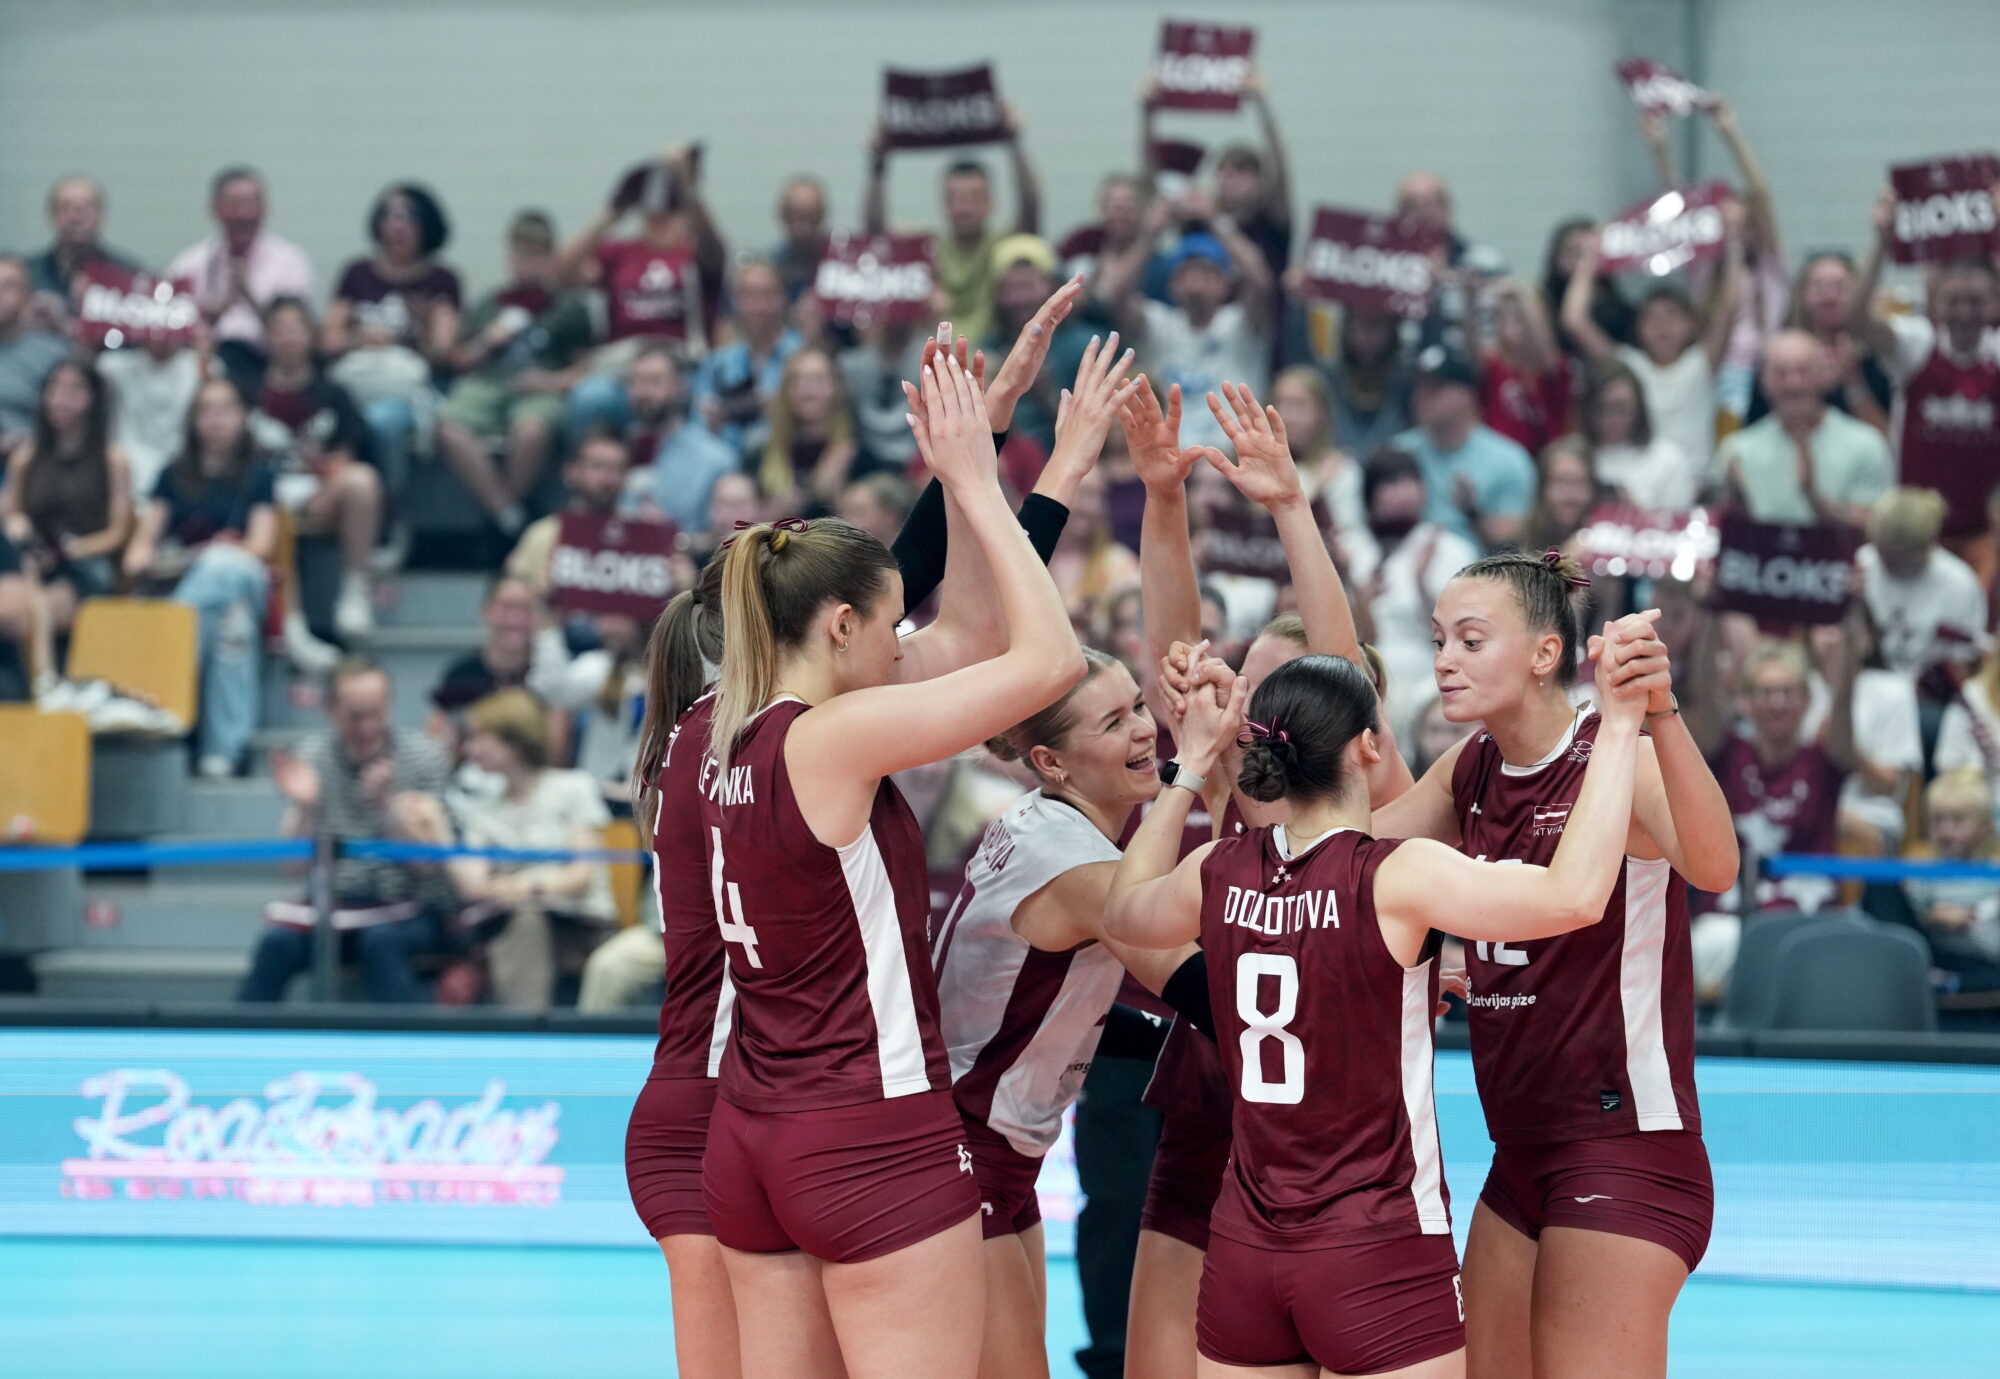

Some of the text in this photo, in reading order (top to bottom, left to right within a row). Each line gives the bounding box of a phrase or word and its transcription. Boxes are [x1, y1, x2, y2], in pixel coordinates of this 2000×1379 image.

[1308, 238, 1431, 294] BLOKS
[551, 544, 671, 597] BLOKS
[1719, 549, 1850, 604] BLOKS
[711, 825, 763, 969] 4
[1224, 885, 1340, 935] DOLOTOVA
[1236, 952, 1305, 1104] 8
[1471, 993, 1511, 1010] Latvijas
